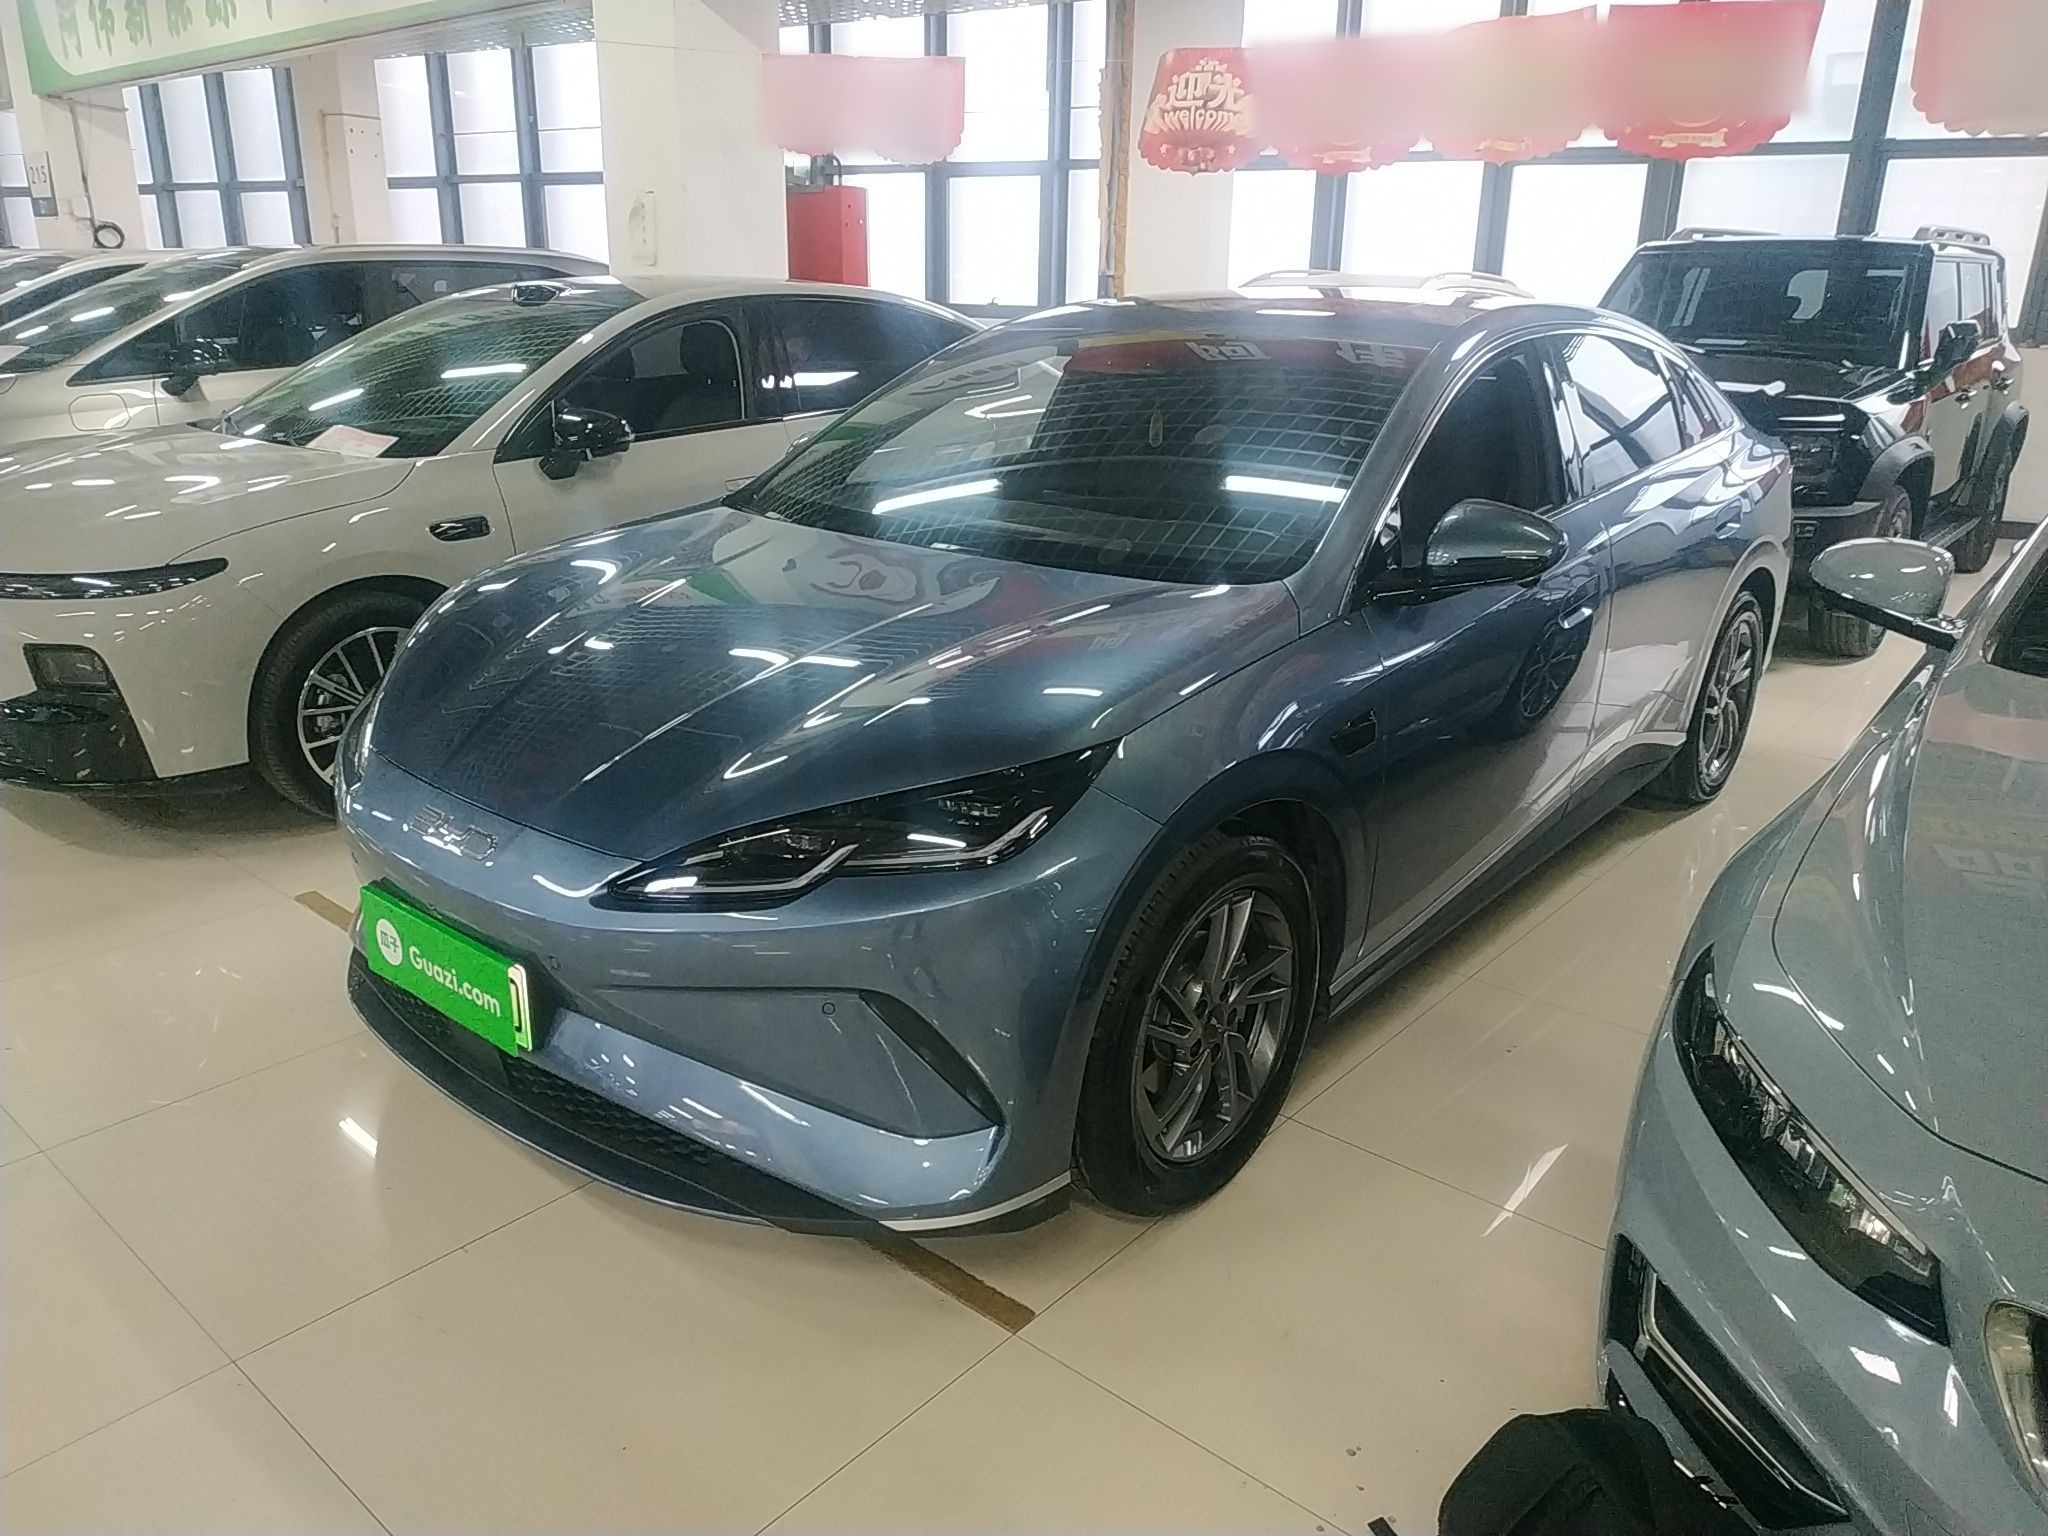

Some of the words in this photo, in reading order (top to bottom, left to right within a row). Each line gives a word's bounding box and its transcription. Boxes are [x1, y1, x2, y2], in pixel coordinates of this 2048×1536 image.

[29, 164, 48, 185] 215
[409, 804, 498, 861] BYD
[379, 929, 400, 954] 瓜子
[408, 945, 502, 1018] Guazi.com
